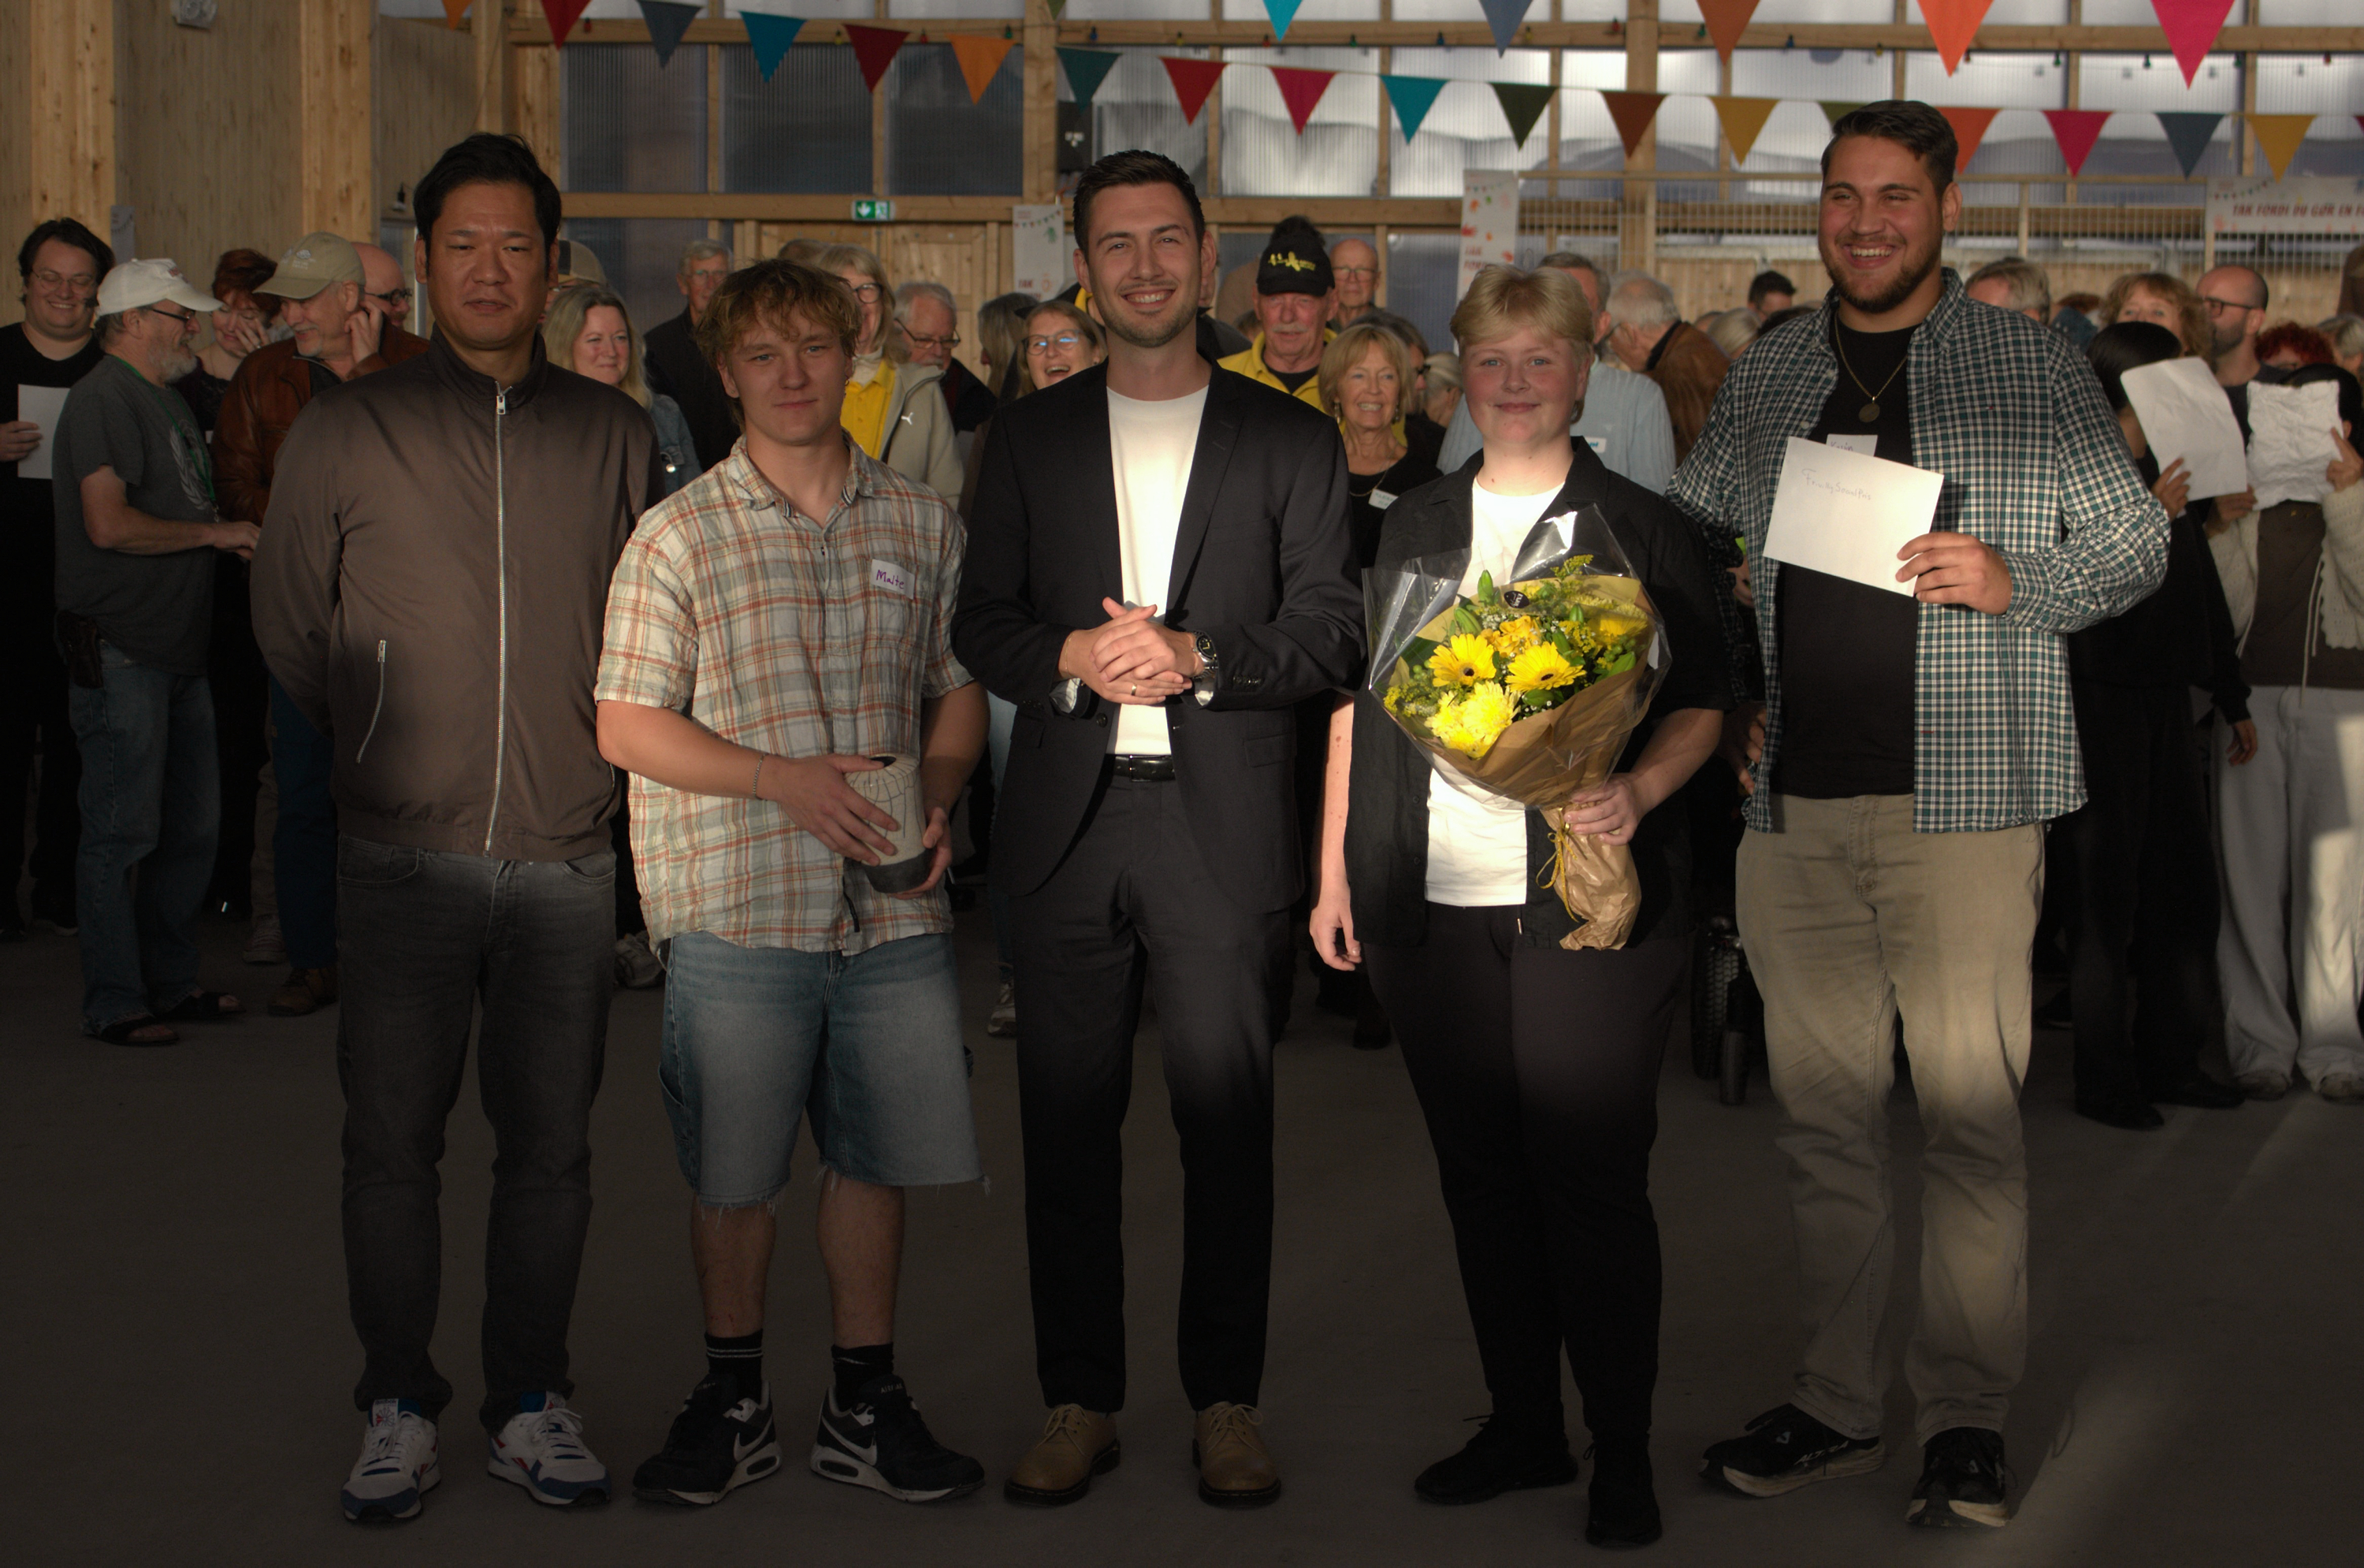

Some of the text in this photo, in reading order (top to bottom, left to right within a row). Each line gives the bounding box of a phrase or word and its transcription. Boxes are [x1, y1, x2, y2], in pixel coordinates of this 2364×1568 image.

[2232, 204, 2252, 217] TAK
[2256, 204, 2288, 217] FORDI
[2292, 204, 2307, 217] DU
[2338, 204, 2353, 217] EN
[876, 569, 905, 589] Malte
[1793, 1440, 1849, 1466] ALTRA
